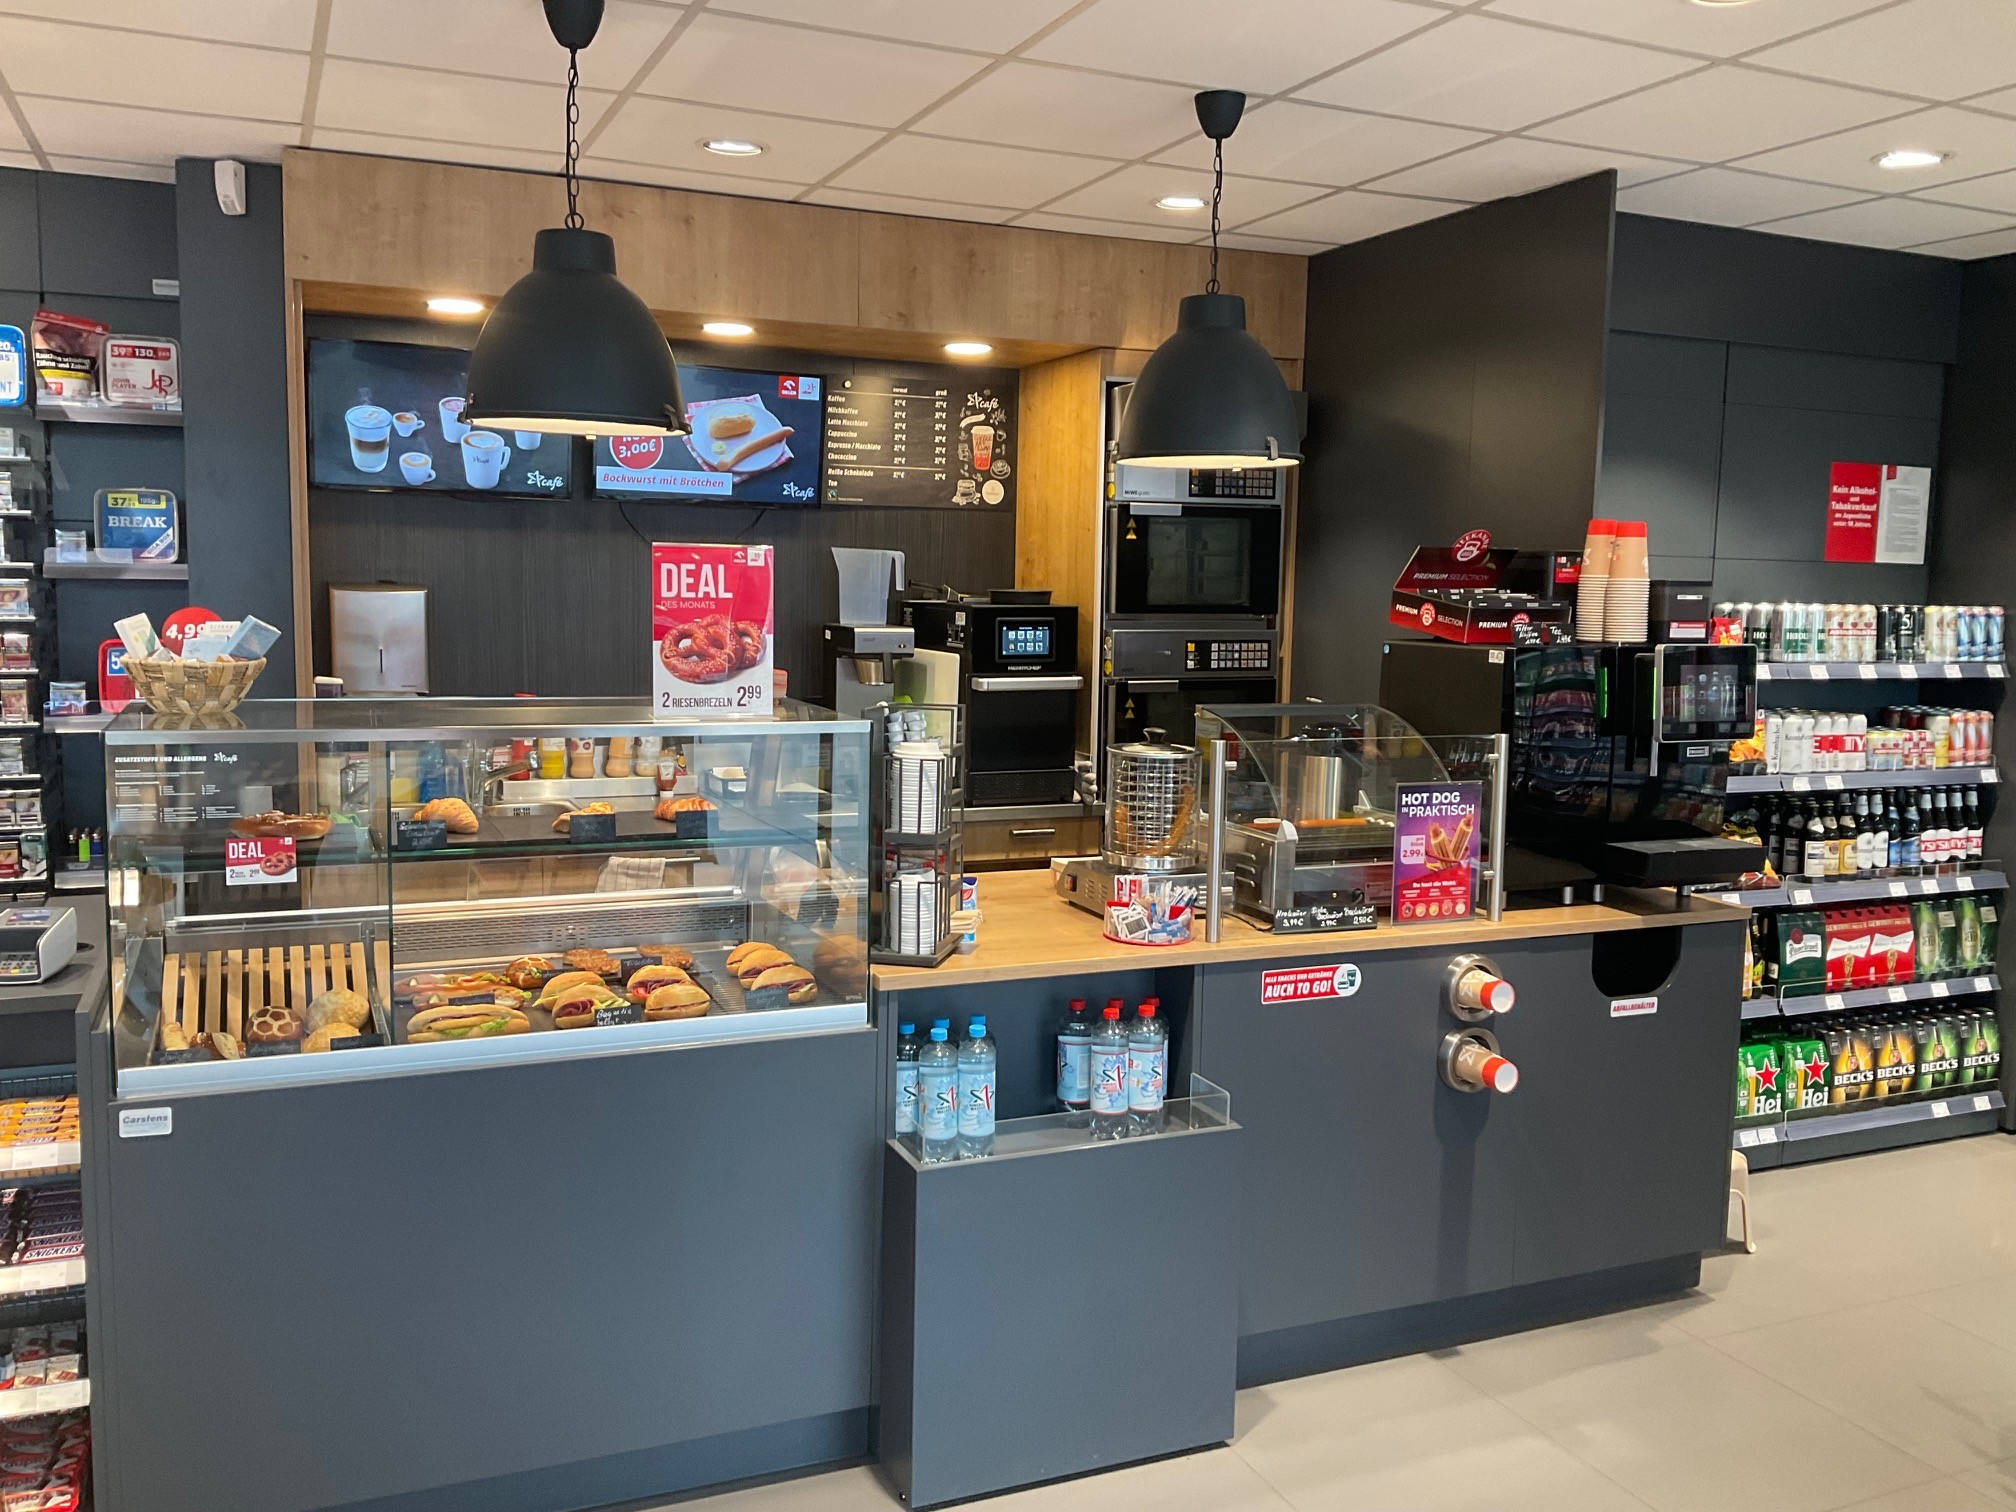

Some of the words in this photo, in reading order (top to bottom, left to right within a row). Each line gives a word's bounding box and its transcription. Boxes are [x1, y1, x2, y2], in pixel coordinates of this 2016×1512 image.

[828, 394, 846, 402] Kaffee
[980, 397, 1000, 412] café
[828, 406, 859, 415] Milchkaffee
[828, 418, 842, 426] Latte
[828, 430, 858, 438] Cappuccino
[618, 438, 656, 458] 3,00€
[828, 441, 851, 450] Espresso
[541, 475, 563, 490] café
[602, 473, 657, 484] Bockwurst
[659, 475, 677, 486] mit
[680, 476, 724, 488] Brötchen
[795, 486, 815, 500] café
[1833, 485, 1848, 494] Kein
[1831, 501, 1877, 511] Tabakverkauf
[108, 515, 168, 528] BREAK
[660, 563, 733, 599] DEAL
[1413, 572, 1449, 580] PREMIUM
[1449, 573, 1490, 581] SELECTION
[661, 601, 678, 609] DES
[680, 601, 716, 609] MONATS
[1395, 603, 1418, 615] PREMIUM
[1437, 615, 1463, 627] SELECTION
[1550, 626, 1563, 635] Tee
[662, 692, 670, 707] 2
[672, 697, 733, 707] RIESENBREZELN
[1771, 724, 1781, 761] Krombacher
[1402, 793, 1430, 805] HOT
[1432, 792, 1460, 804] DOG
[1409, 804, 1475, 817] PRAKTISCH
[228, 841, 266, 859] DEAL
[230, 869, 235, 878] 2
[1277, 974, 1297, 982] SNACKS
[1297, 973, 1308, 981] UND
[1308, 970, 1333, 979] GETRÄNKE
[1264, 983, 1294, 999] AUCH
[1296, 982, 1309, 996] TO
[1312, 979, 1331, 994] GO!
[1612, 1001, 1656, 1012] ABFALLBEHÄLTER
[1921, 1058, 1958, 1074] BECK'S
[1964, 1053, 2000, 1067] BECK'S
[1834, 1070, 1874, 1086] BECK'S
[1877, 1064, 1916, 1079] BECK'S
[1754, 1093, 1782, 1115] Hei
[1802, 1086, 1829, 1109] Hei
[123, 1114, 169, 1124] Carstens
[26, 1245, 80, 1258] SNICKERS
